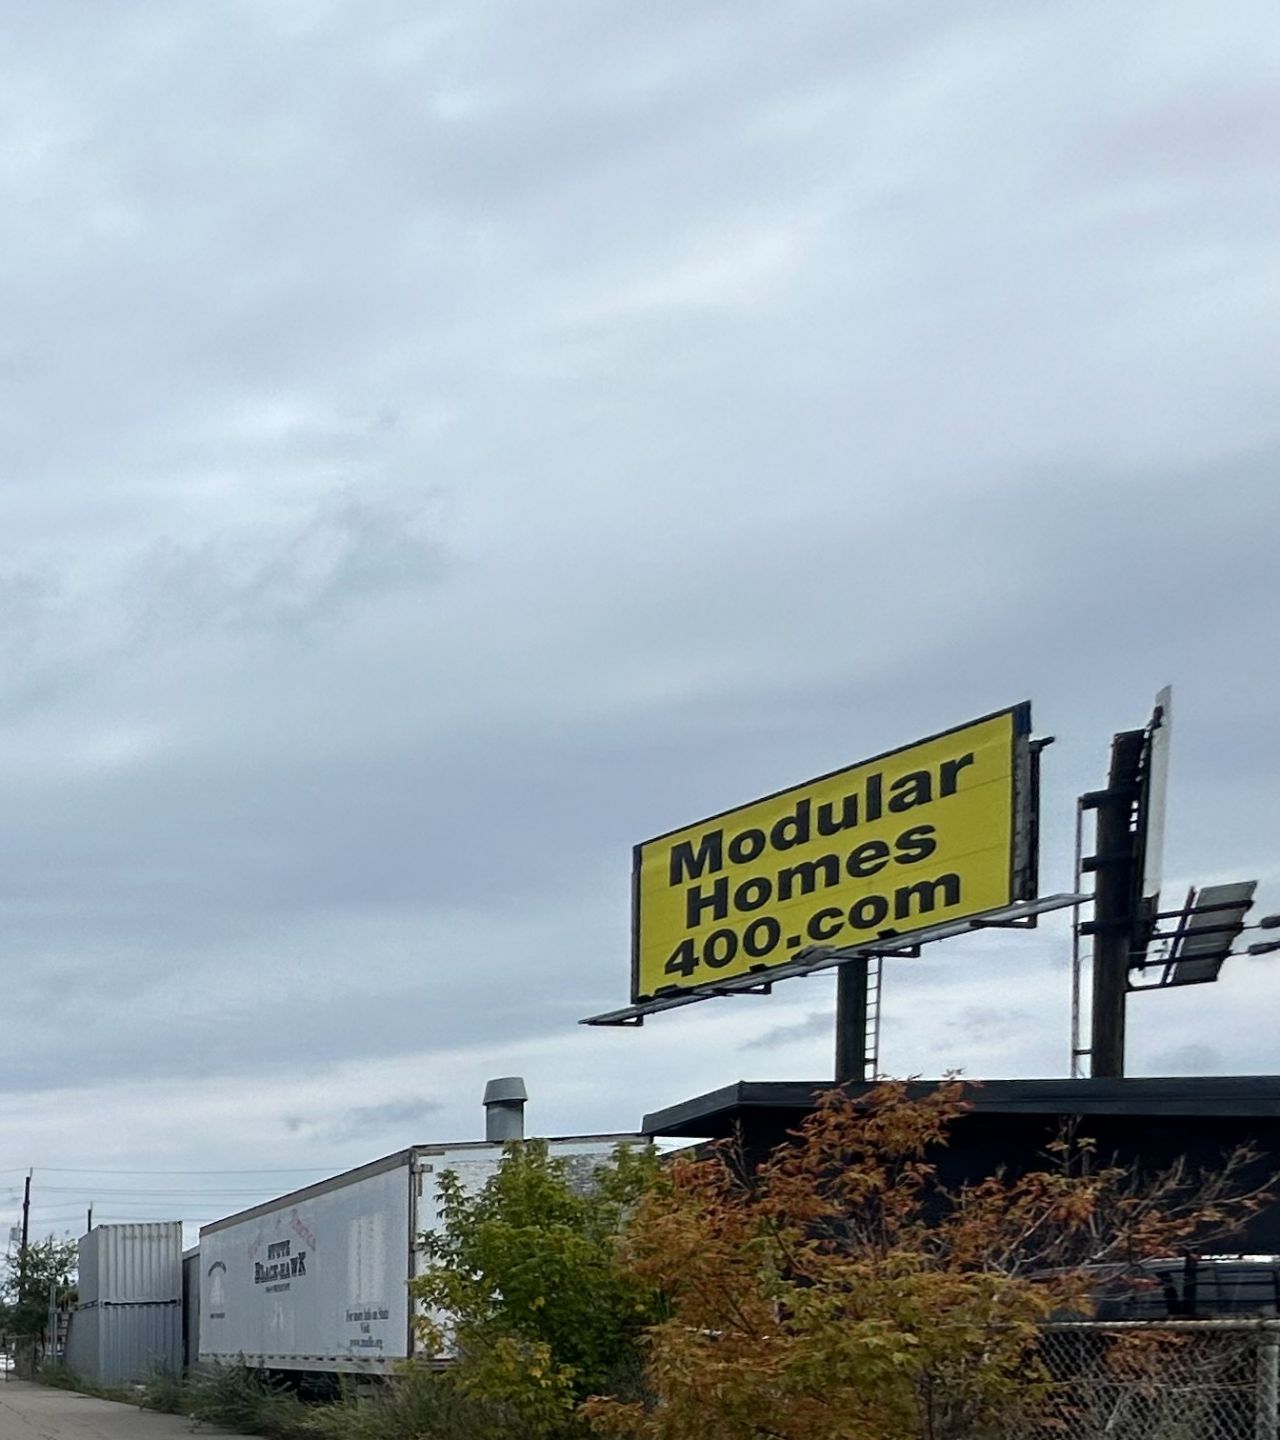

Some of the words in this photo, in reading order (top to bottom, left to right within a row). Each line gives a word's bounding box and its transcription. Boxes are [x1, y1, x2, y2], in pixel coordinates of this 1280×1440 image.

[669, 752, 974, 887] Modular
[664, 872, 961, 978] 400.com
[686, 824, 937, 929] Homes
